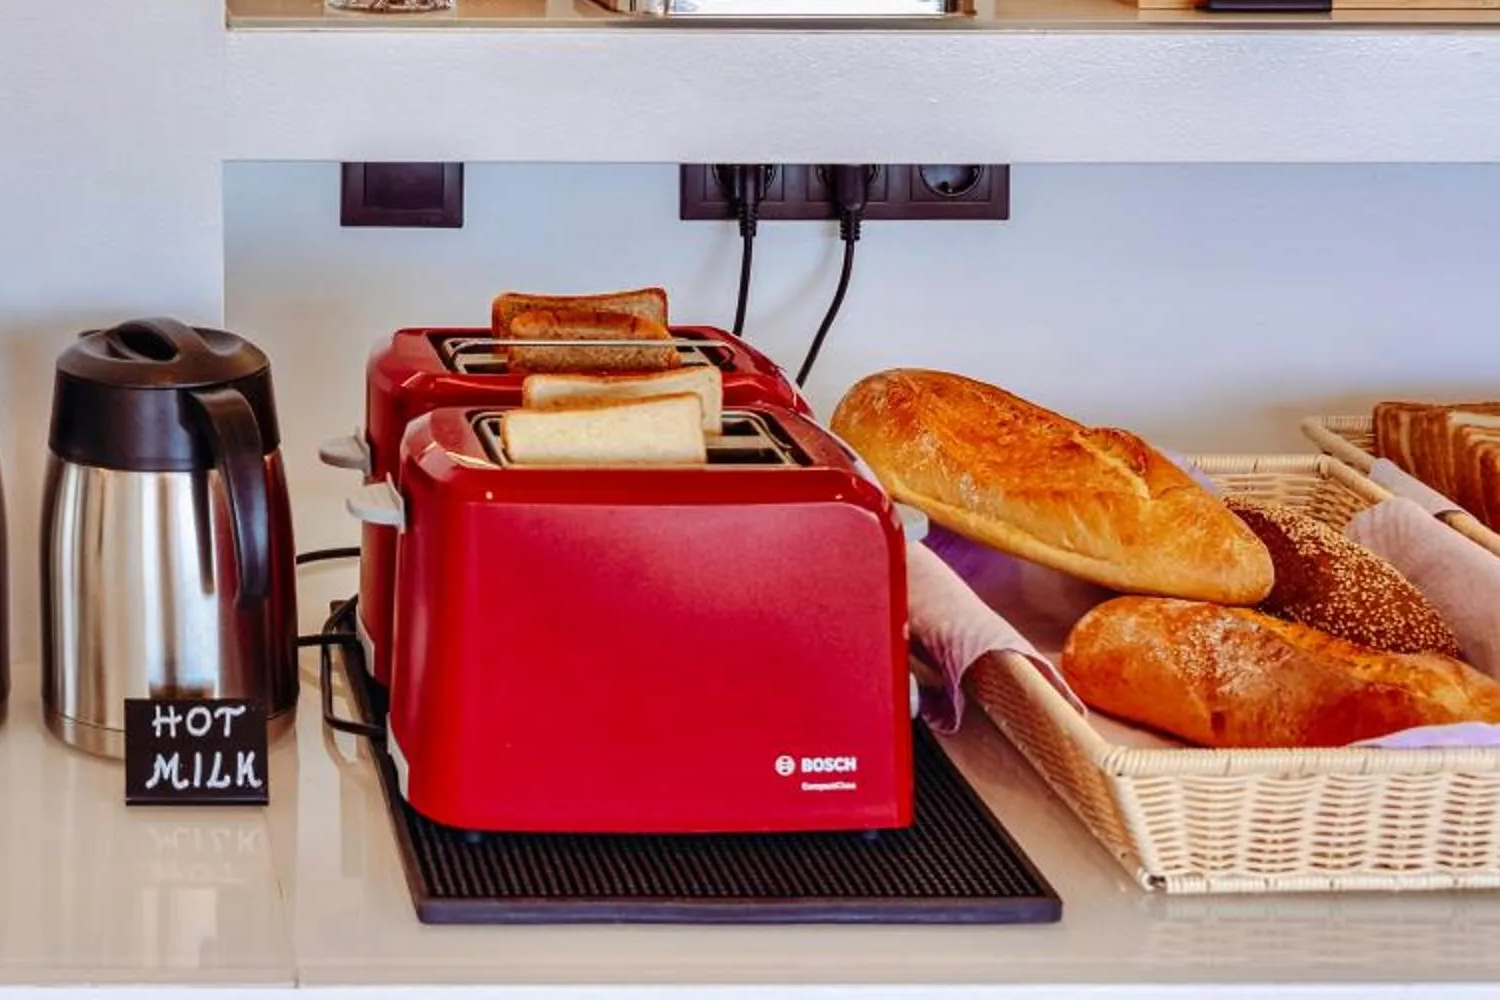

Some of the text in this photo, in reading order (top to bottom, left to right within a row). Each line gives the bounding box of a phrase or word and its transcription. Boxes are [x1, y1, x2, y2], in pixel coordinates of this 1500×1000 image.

[152, 705, 247, 738] HOT
[145, 751, 263, 789] MILK
[801, 757, 857, 773] BOSCH
